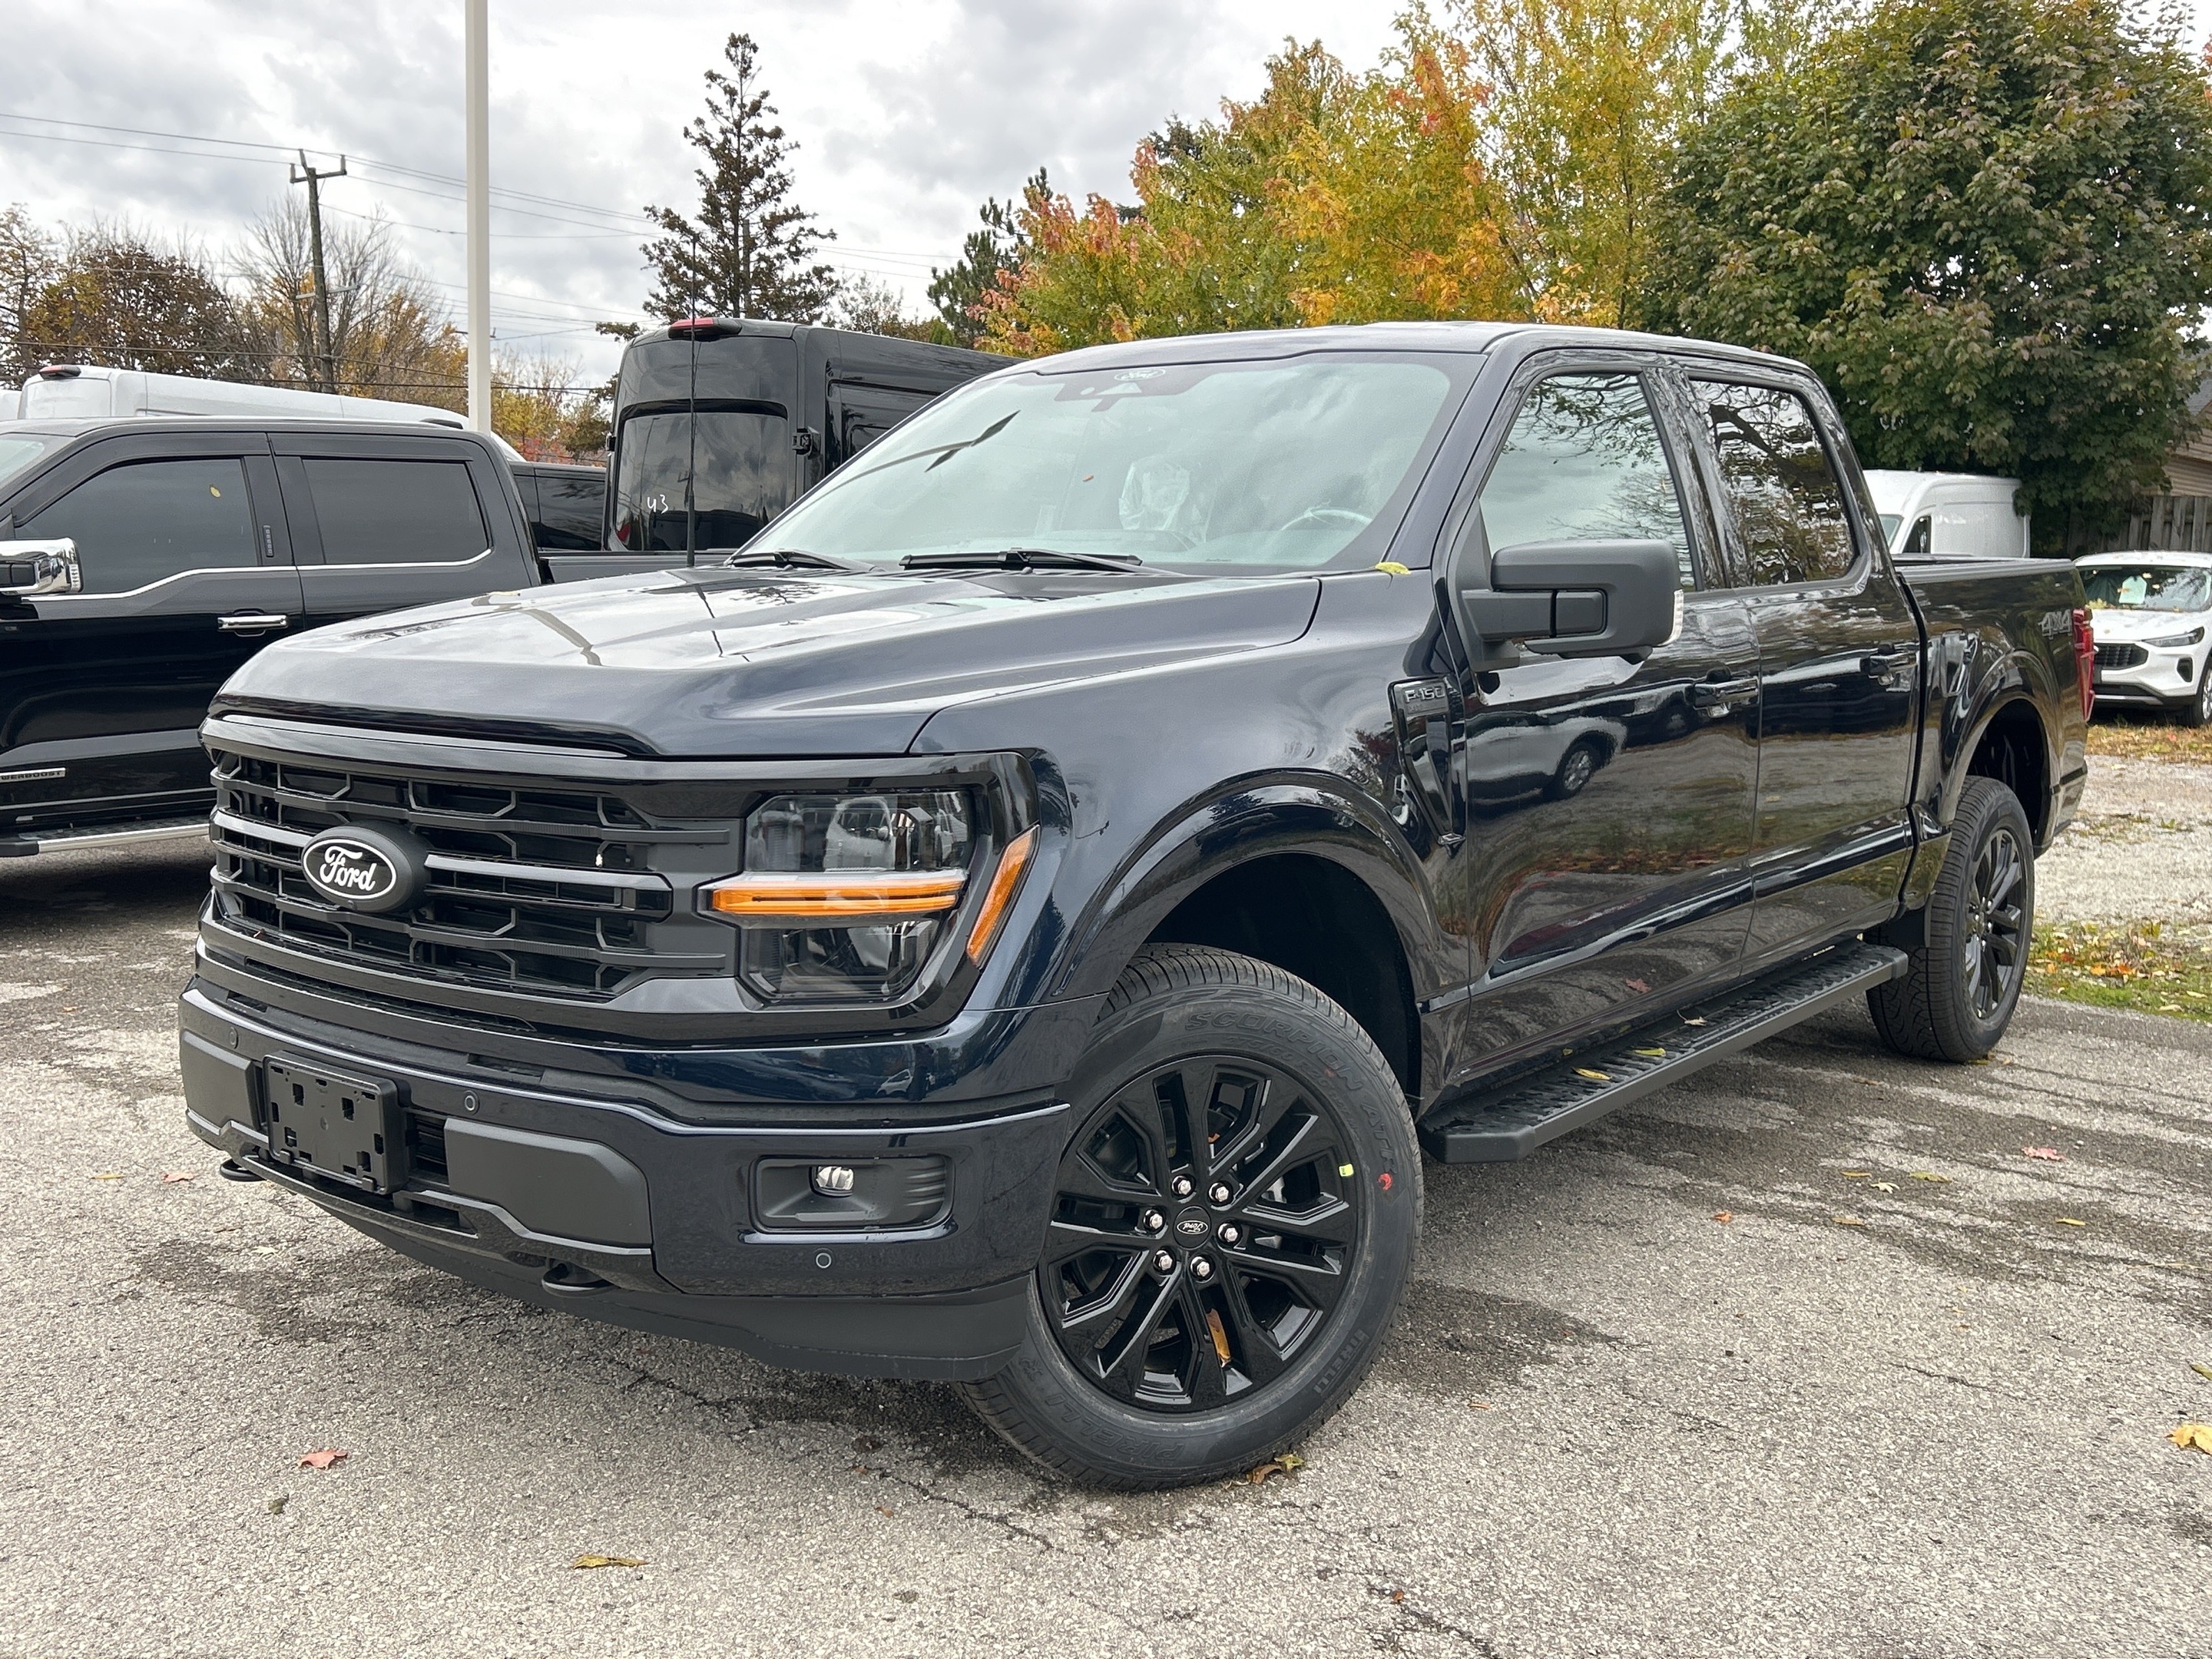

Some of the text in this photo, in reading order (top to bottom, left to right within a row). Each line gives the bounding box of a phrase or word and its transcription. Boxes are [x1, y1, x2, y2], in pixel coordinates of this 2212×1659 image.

[647, 494, 669, 514] 43
[1405, 686, 1445, 704] F-150
[320, 846, 377, 891] Ford
[1185, 1011, 1363, 1090] SCORPION
[1359, 1102, 1397, 1175] ATR
[1183, 1222, 1204, 1233] Ford
[1313, 1329, 1370, 1394] PIRELLI
[1044, 1394, 1185, 1459] PIRELLI
